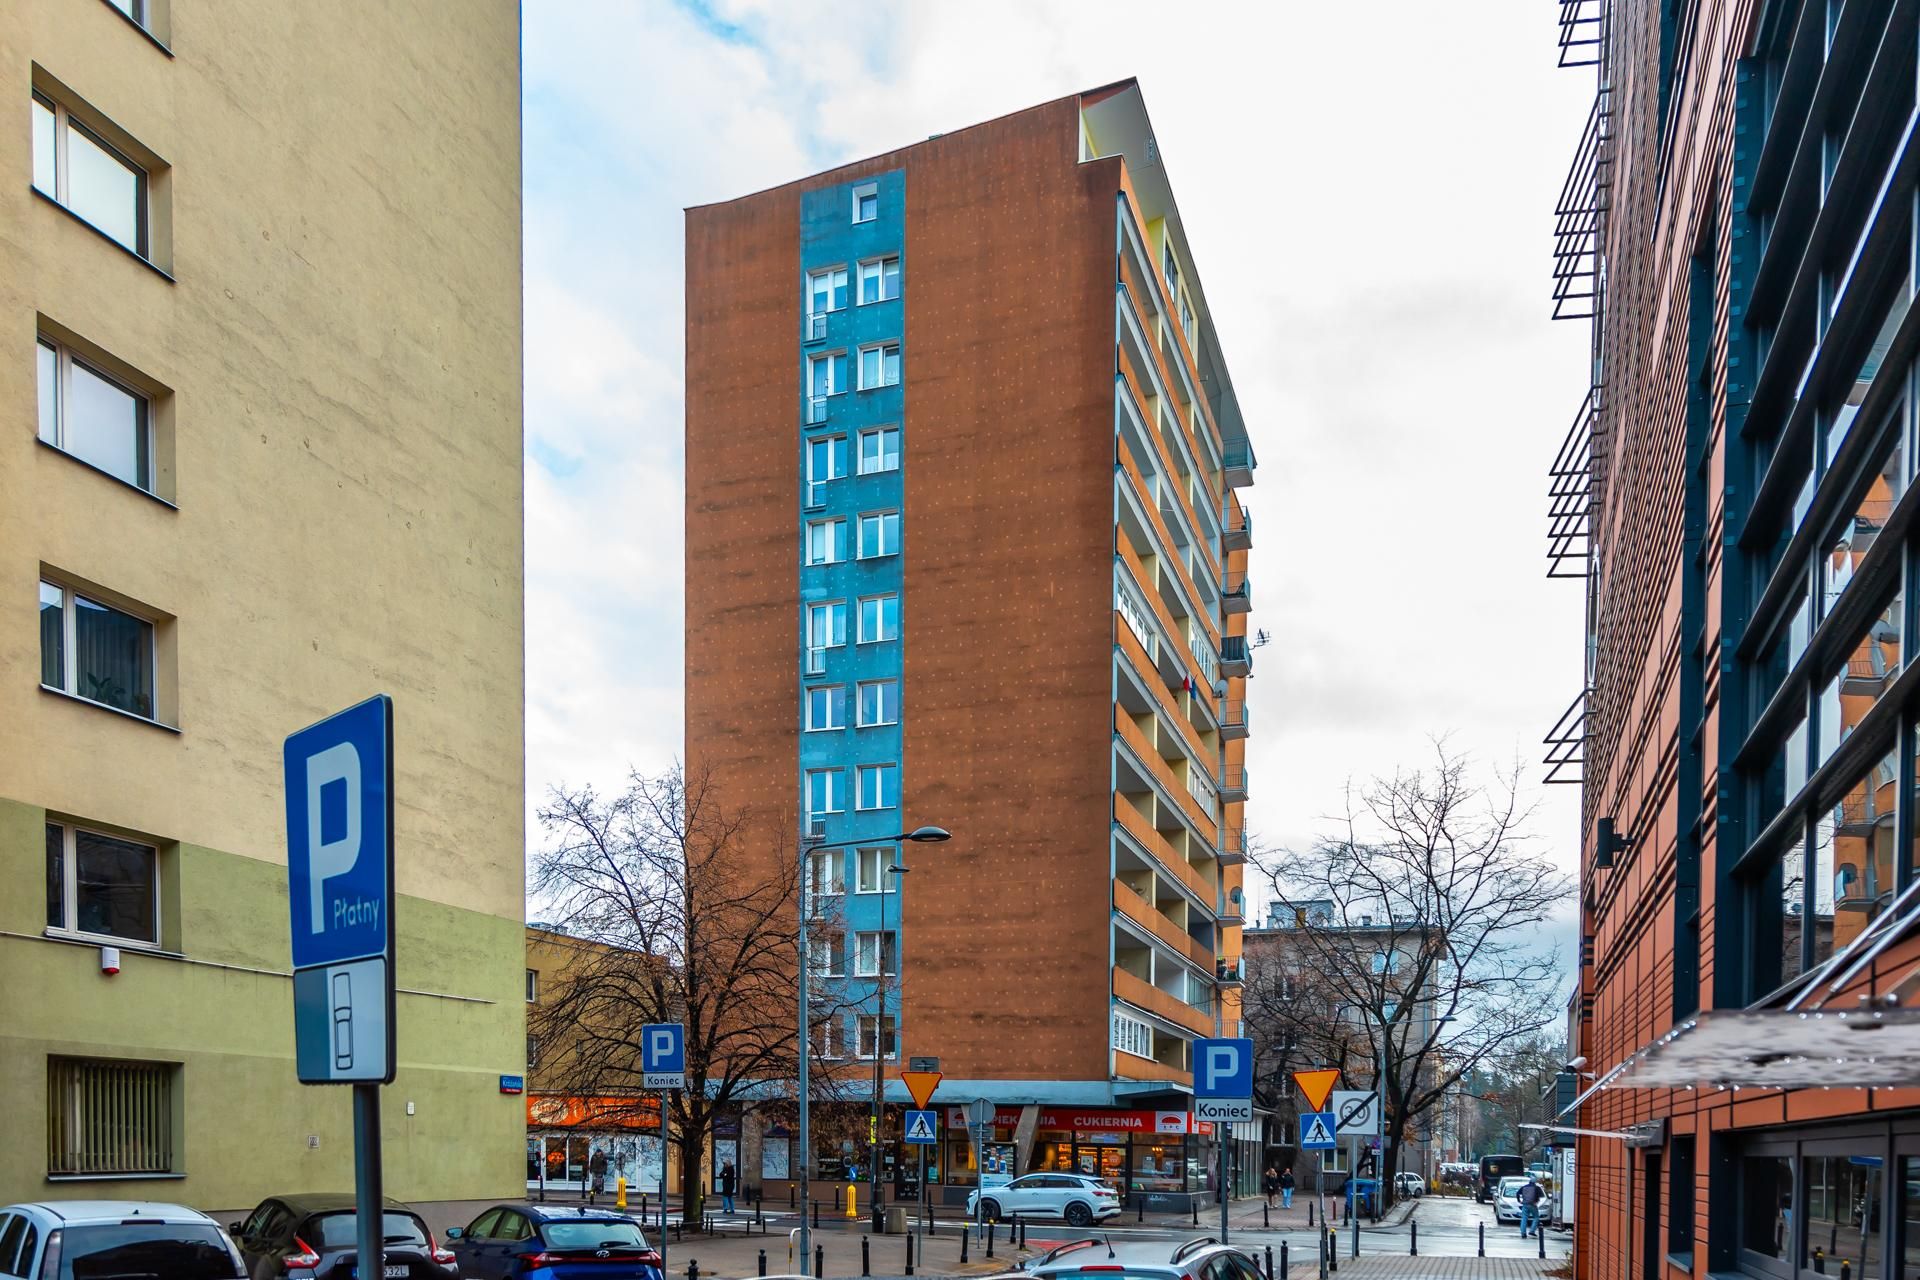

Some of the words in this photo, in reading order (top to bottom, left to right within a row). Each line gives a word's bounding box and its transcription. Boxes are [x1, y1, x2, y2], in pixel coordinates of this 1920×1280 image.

[307, 741, 362, 935] P
[334, 897, 380, 932] Płatny
[652, 1030, 674, 1067] P
[647, 1076, 680, 1085] Koniec
[1206, 1046, 1239, 1090] P
[1073, 1116, 1143, 1127] CUKIERNIA
[1198, 1104, 1248, 1118] Koniec
